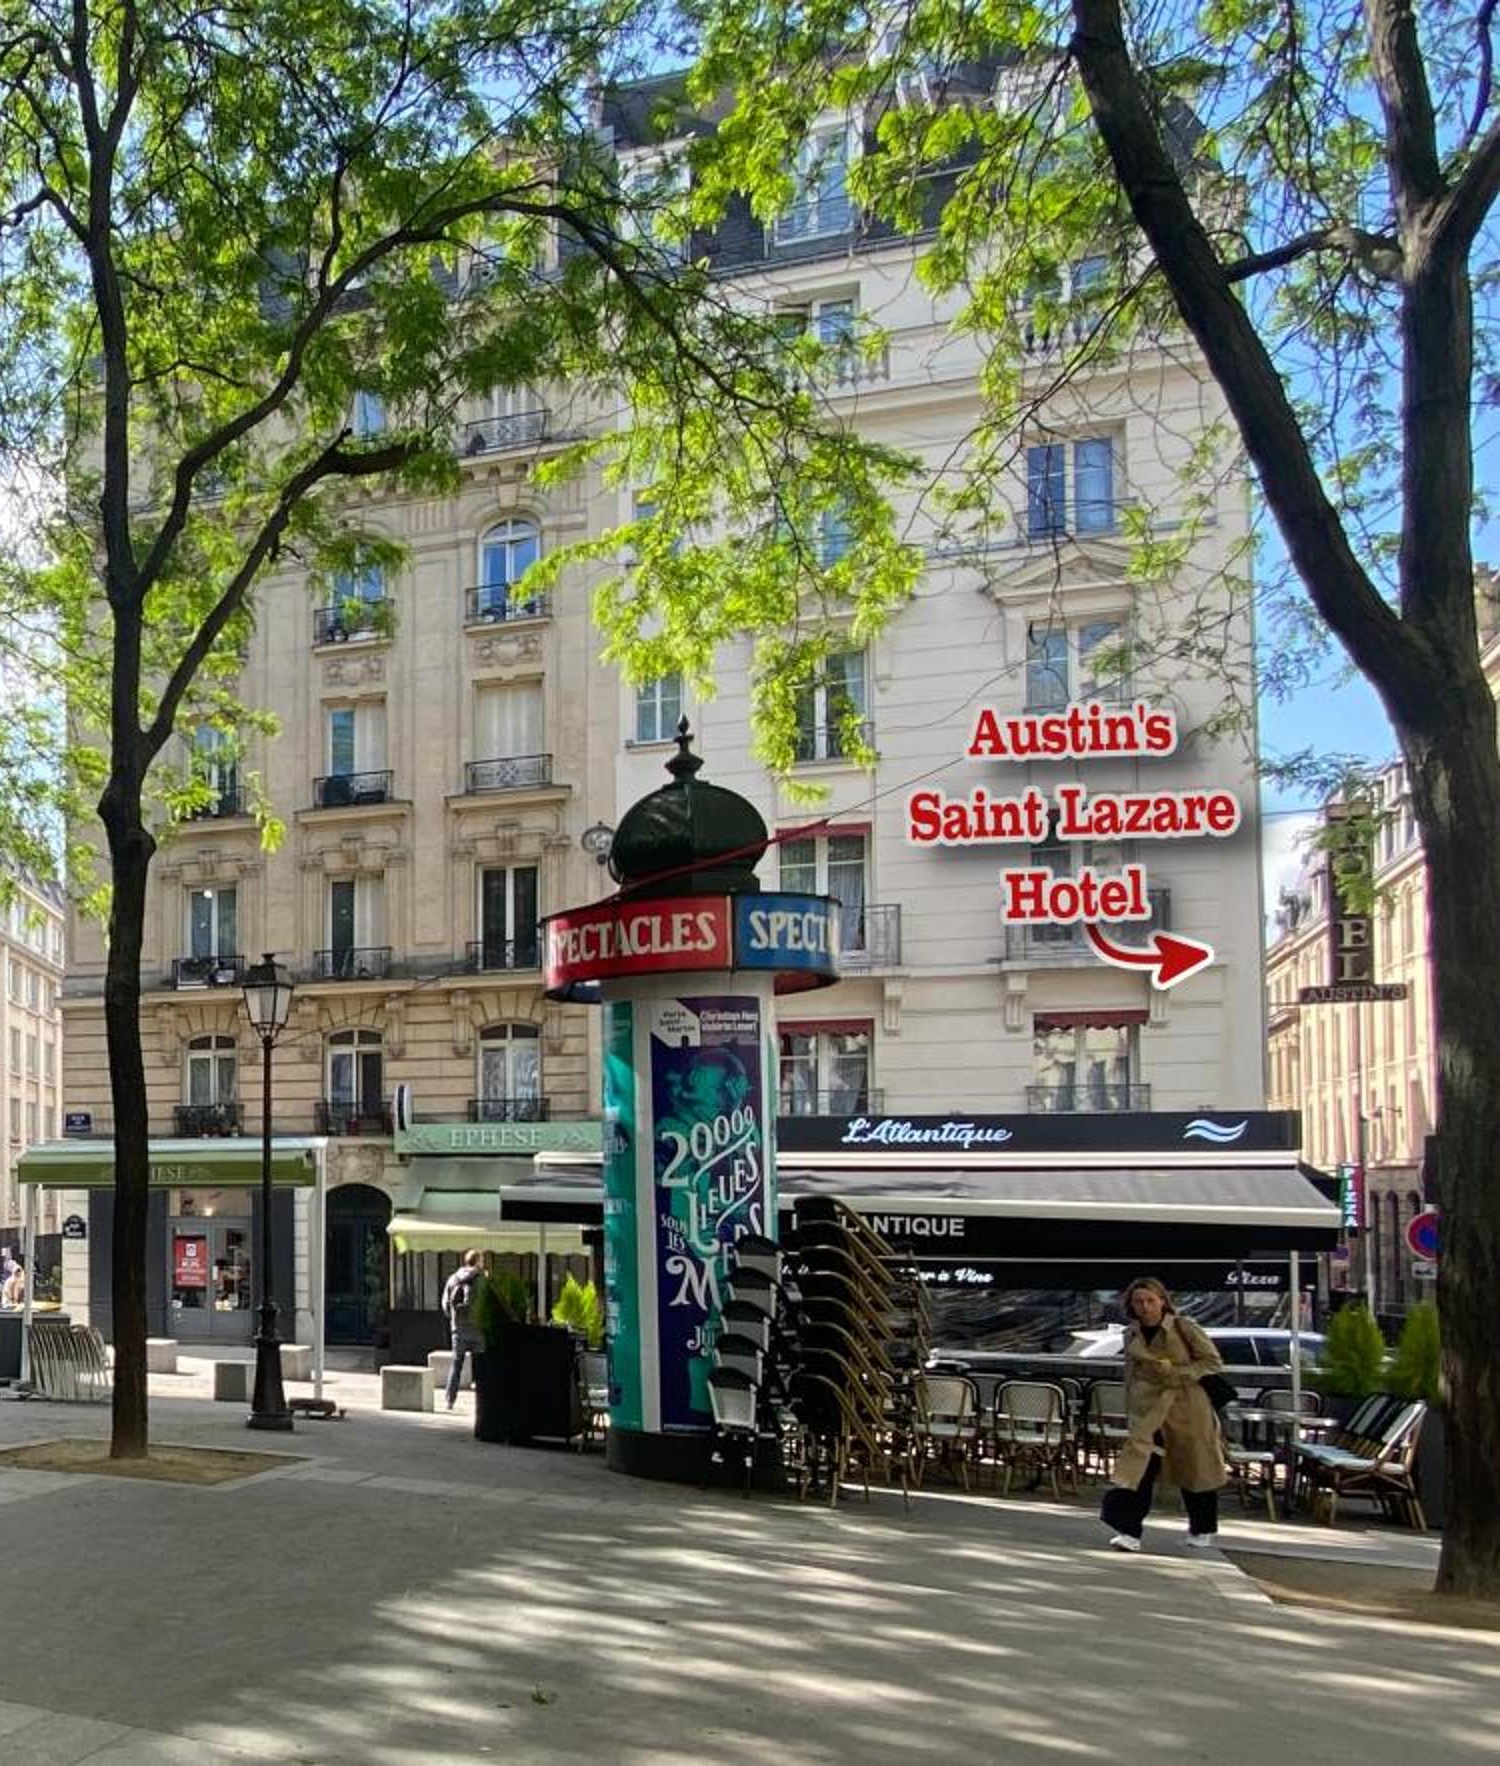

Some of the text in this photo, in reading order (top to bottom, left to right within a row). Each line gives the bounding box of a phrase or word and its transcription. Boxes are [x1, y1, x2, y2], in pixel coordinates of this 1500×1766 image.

[1306, 985, 1404, 1001] AUSTIN'S
[661, 1105, 753, 1187] 20000
[841, 1117, 1013, 1149] L'Atlantique
[1343, 1166, 1359, 1227] PIZZA
